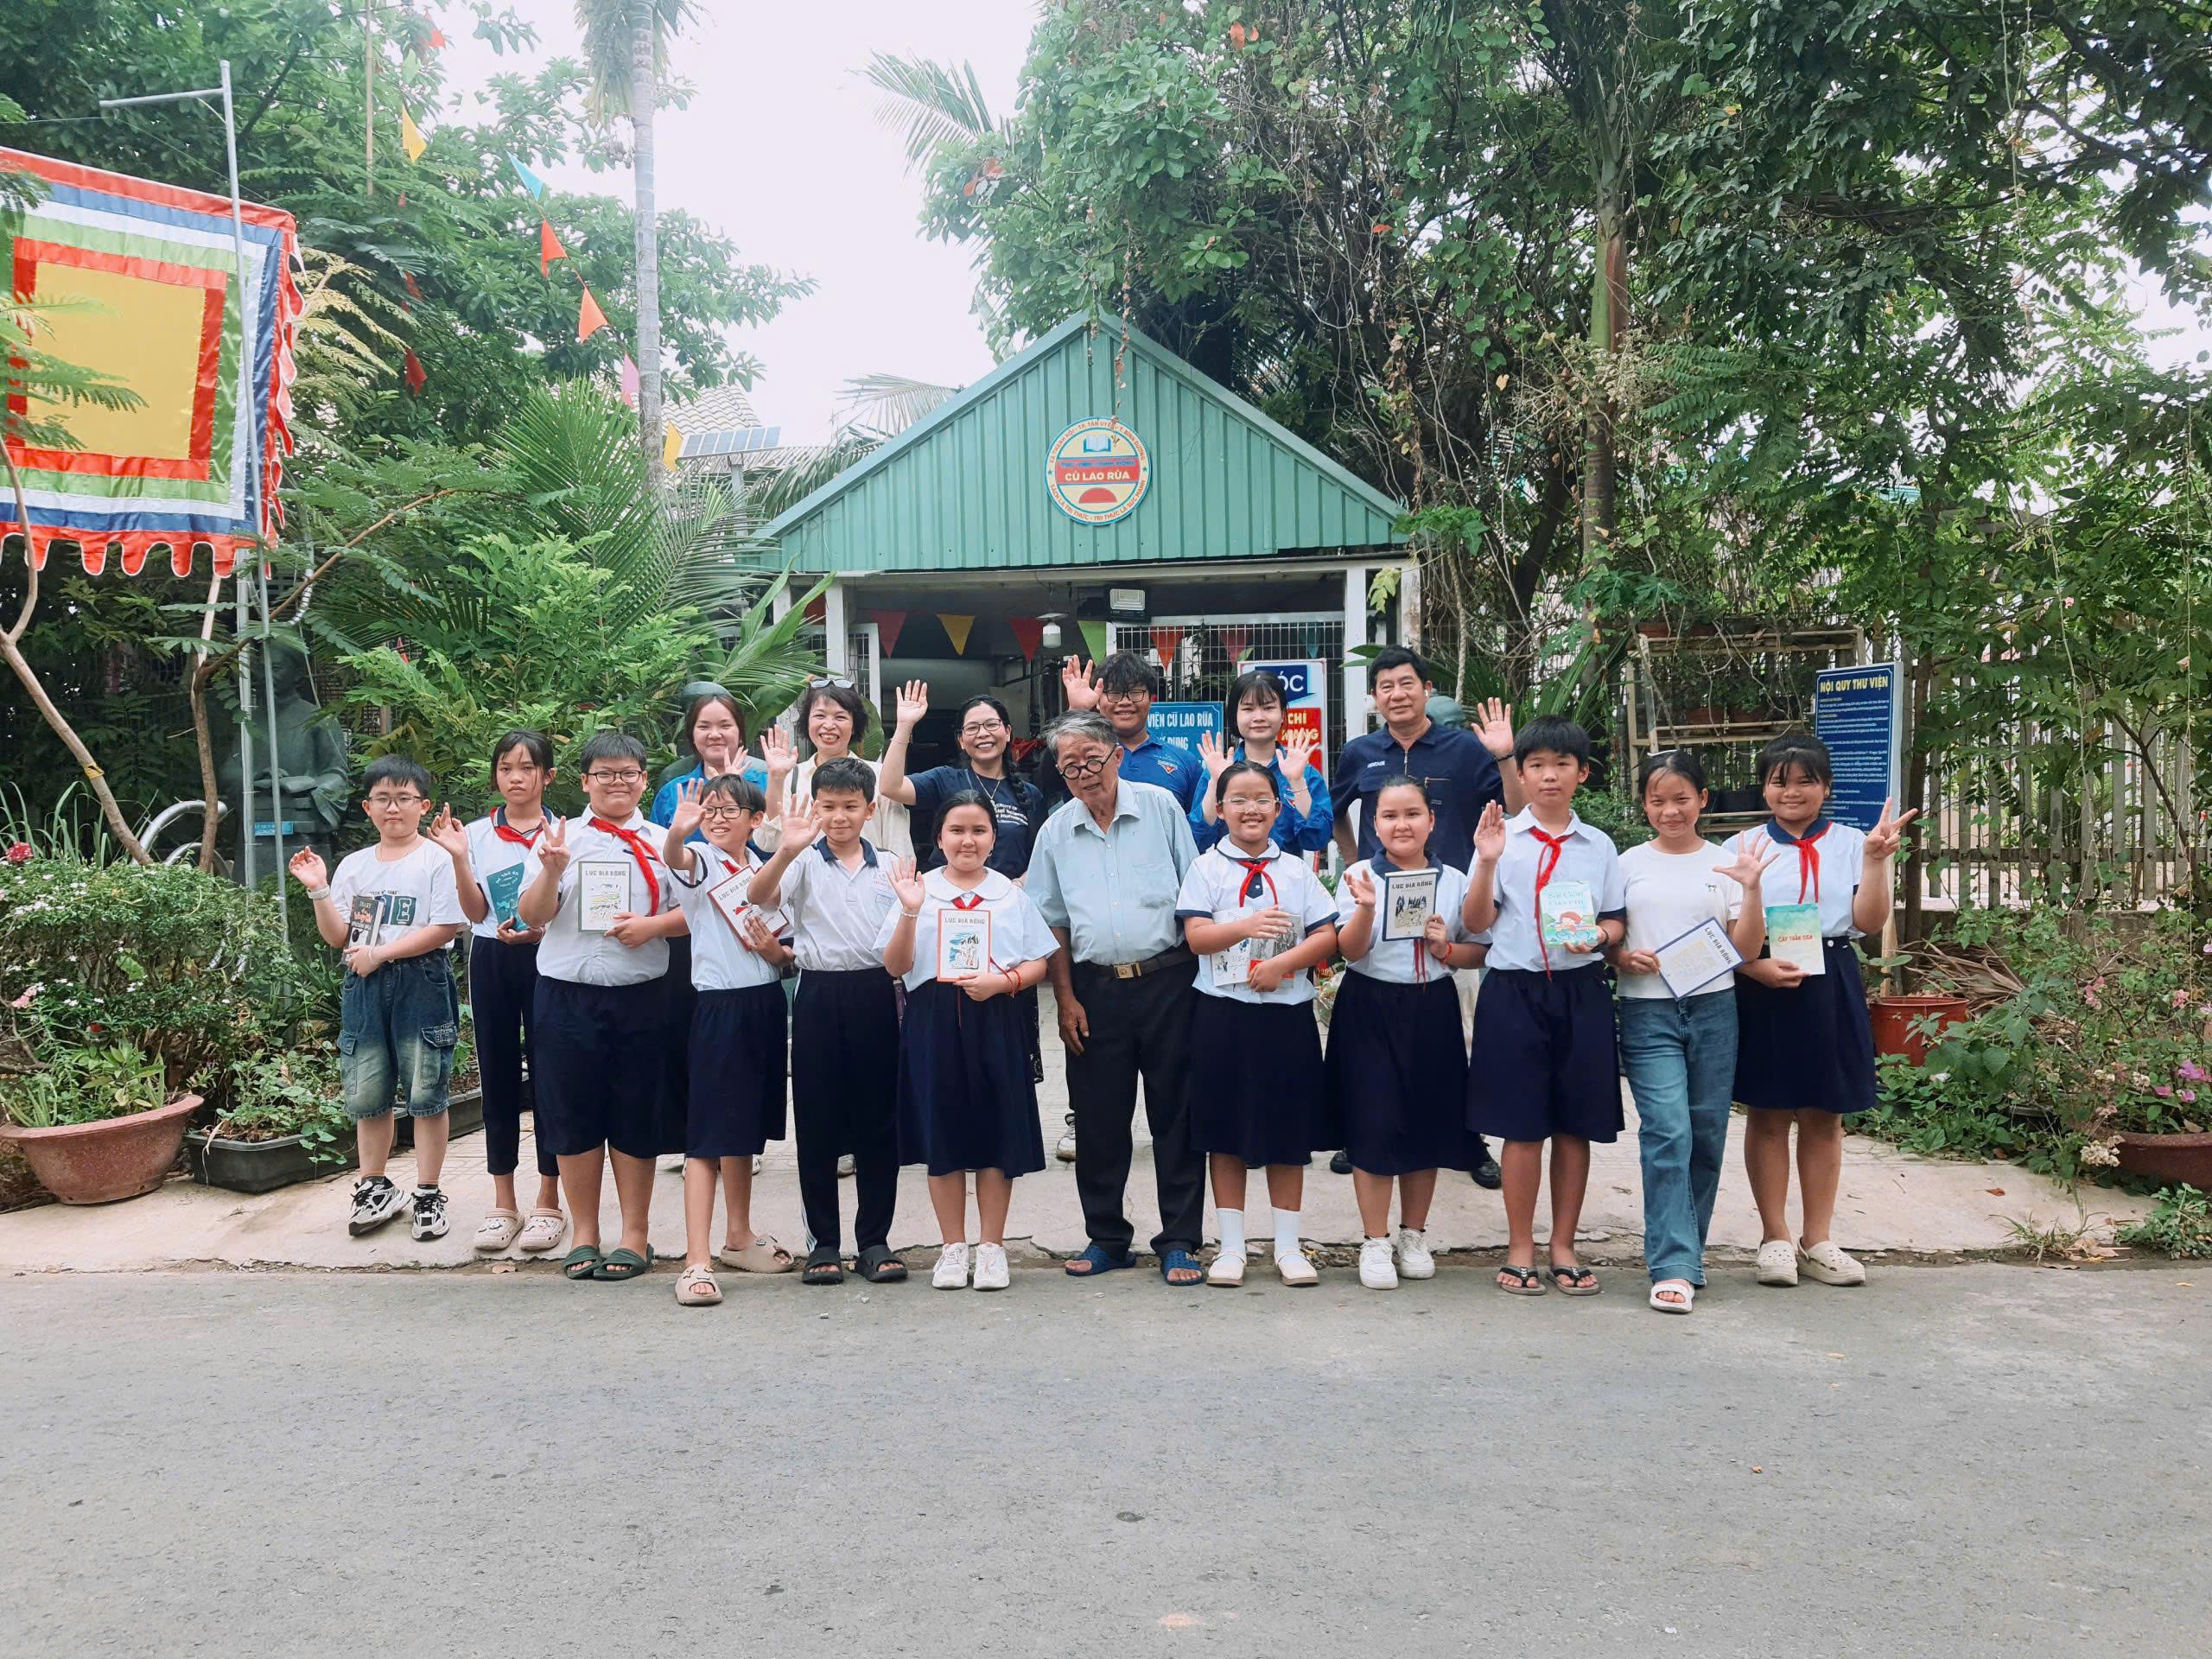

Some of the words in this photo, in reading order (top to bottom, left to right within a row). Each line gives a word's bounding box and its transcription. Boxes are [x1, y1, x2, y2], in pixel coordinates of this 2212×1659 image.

[1083, 472, 1104, 480] LAO
[1821, 680, 1834, 695] NỘI
[1836, 680, 1851, 691] QUY
[1853, 678, 1868, 690] THƯ
[1870, 675, 1888, 690] VIỆN
[1179, 713, 1195, 727] LAO
